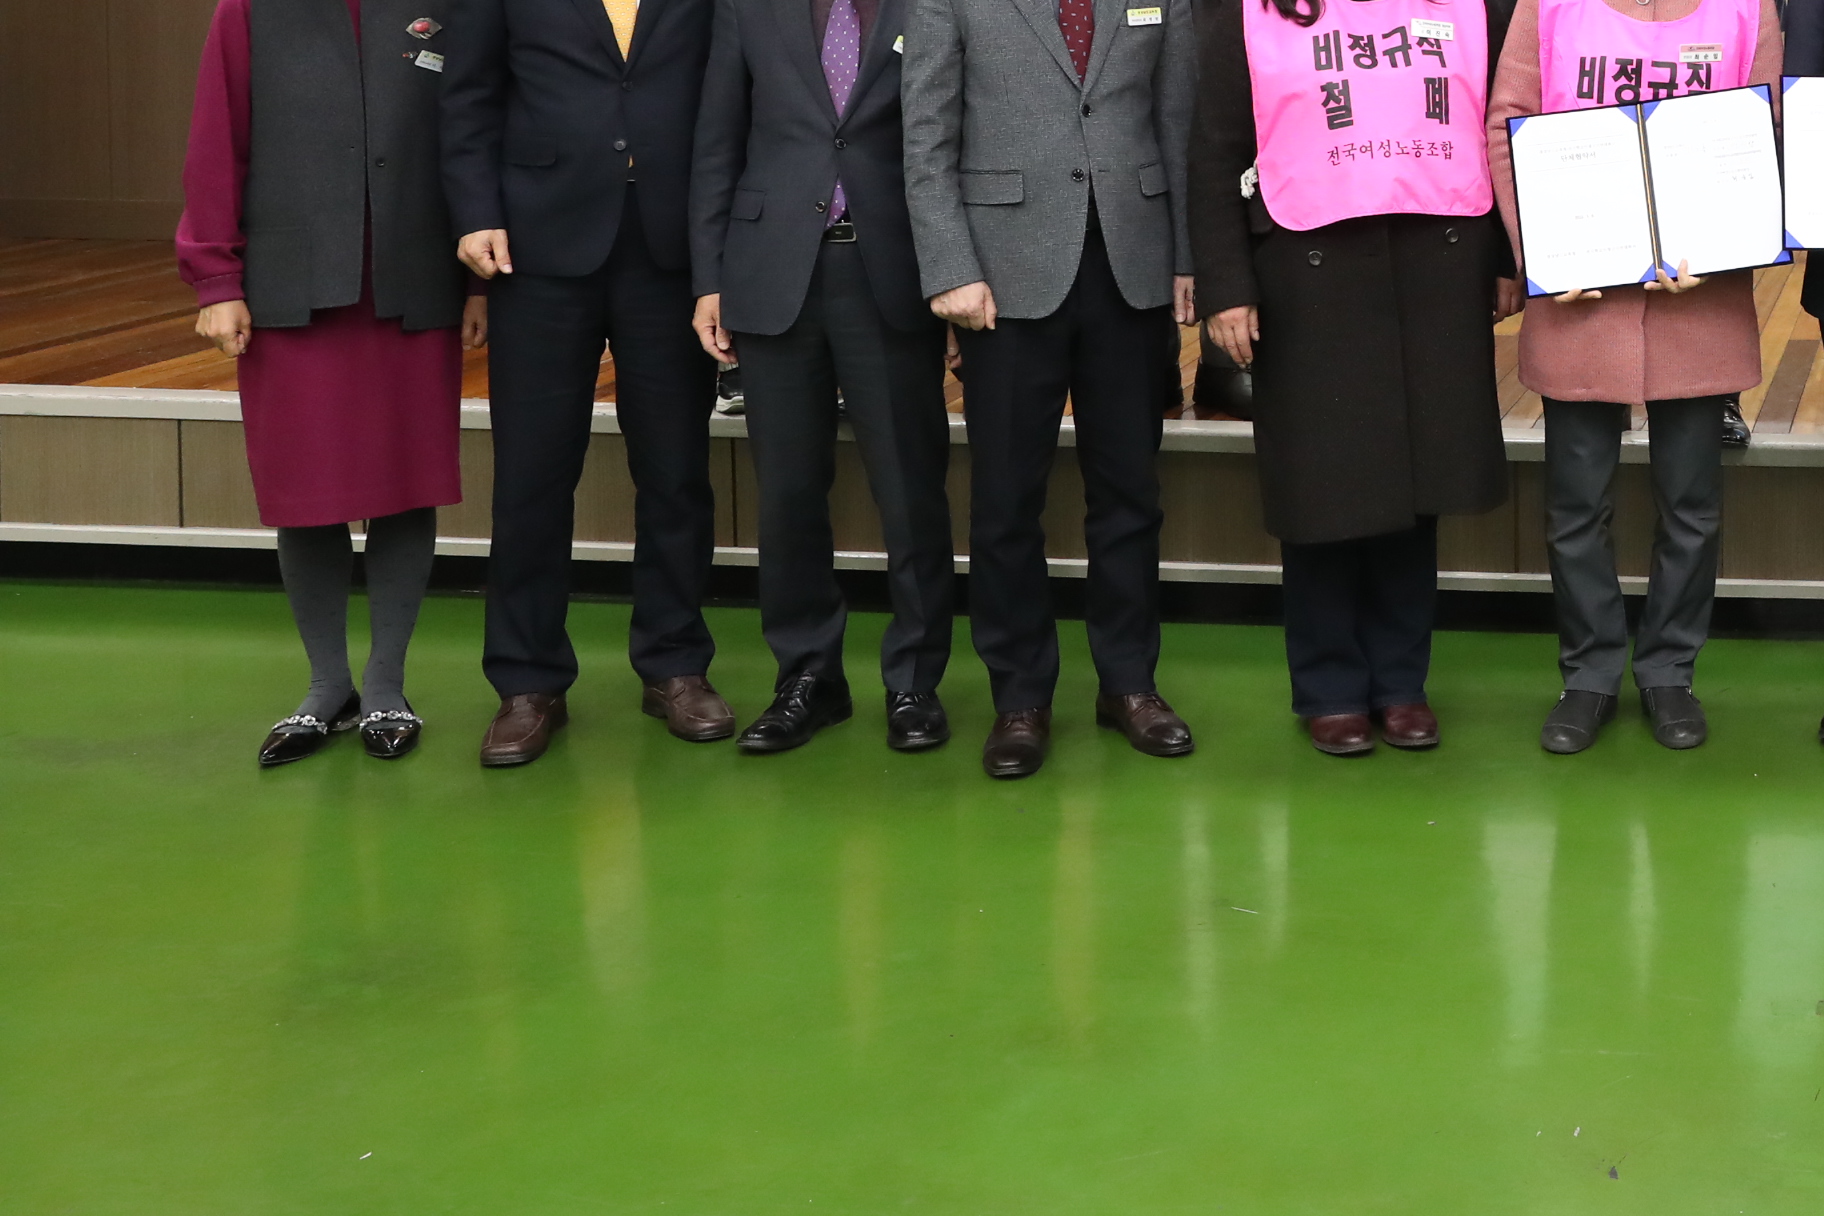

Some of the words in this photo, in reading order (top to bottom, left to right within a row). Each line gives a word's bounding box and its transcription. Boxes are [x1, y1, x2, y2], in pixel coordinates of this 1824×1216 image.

[1312, 25, 1448, 73] 비정규직
[1320, 78, 1354, 131] 철
[1423, 76, 1451, 126] 폐
[1326, 138, 1454, 167] 전국여성노동조합
